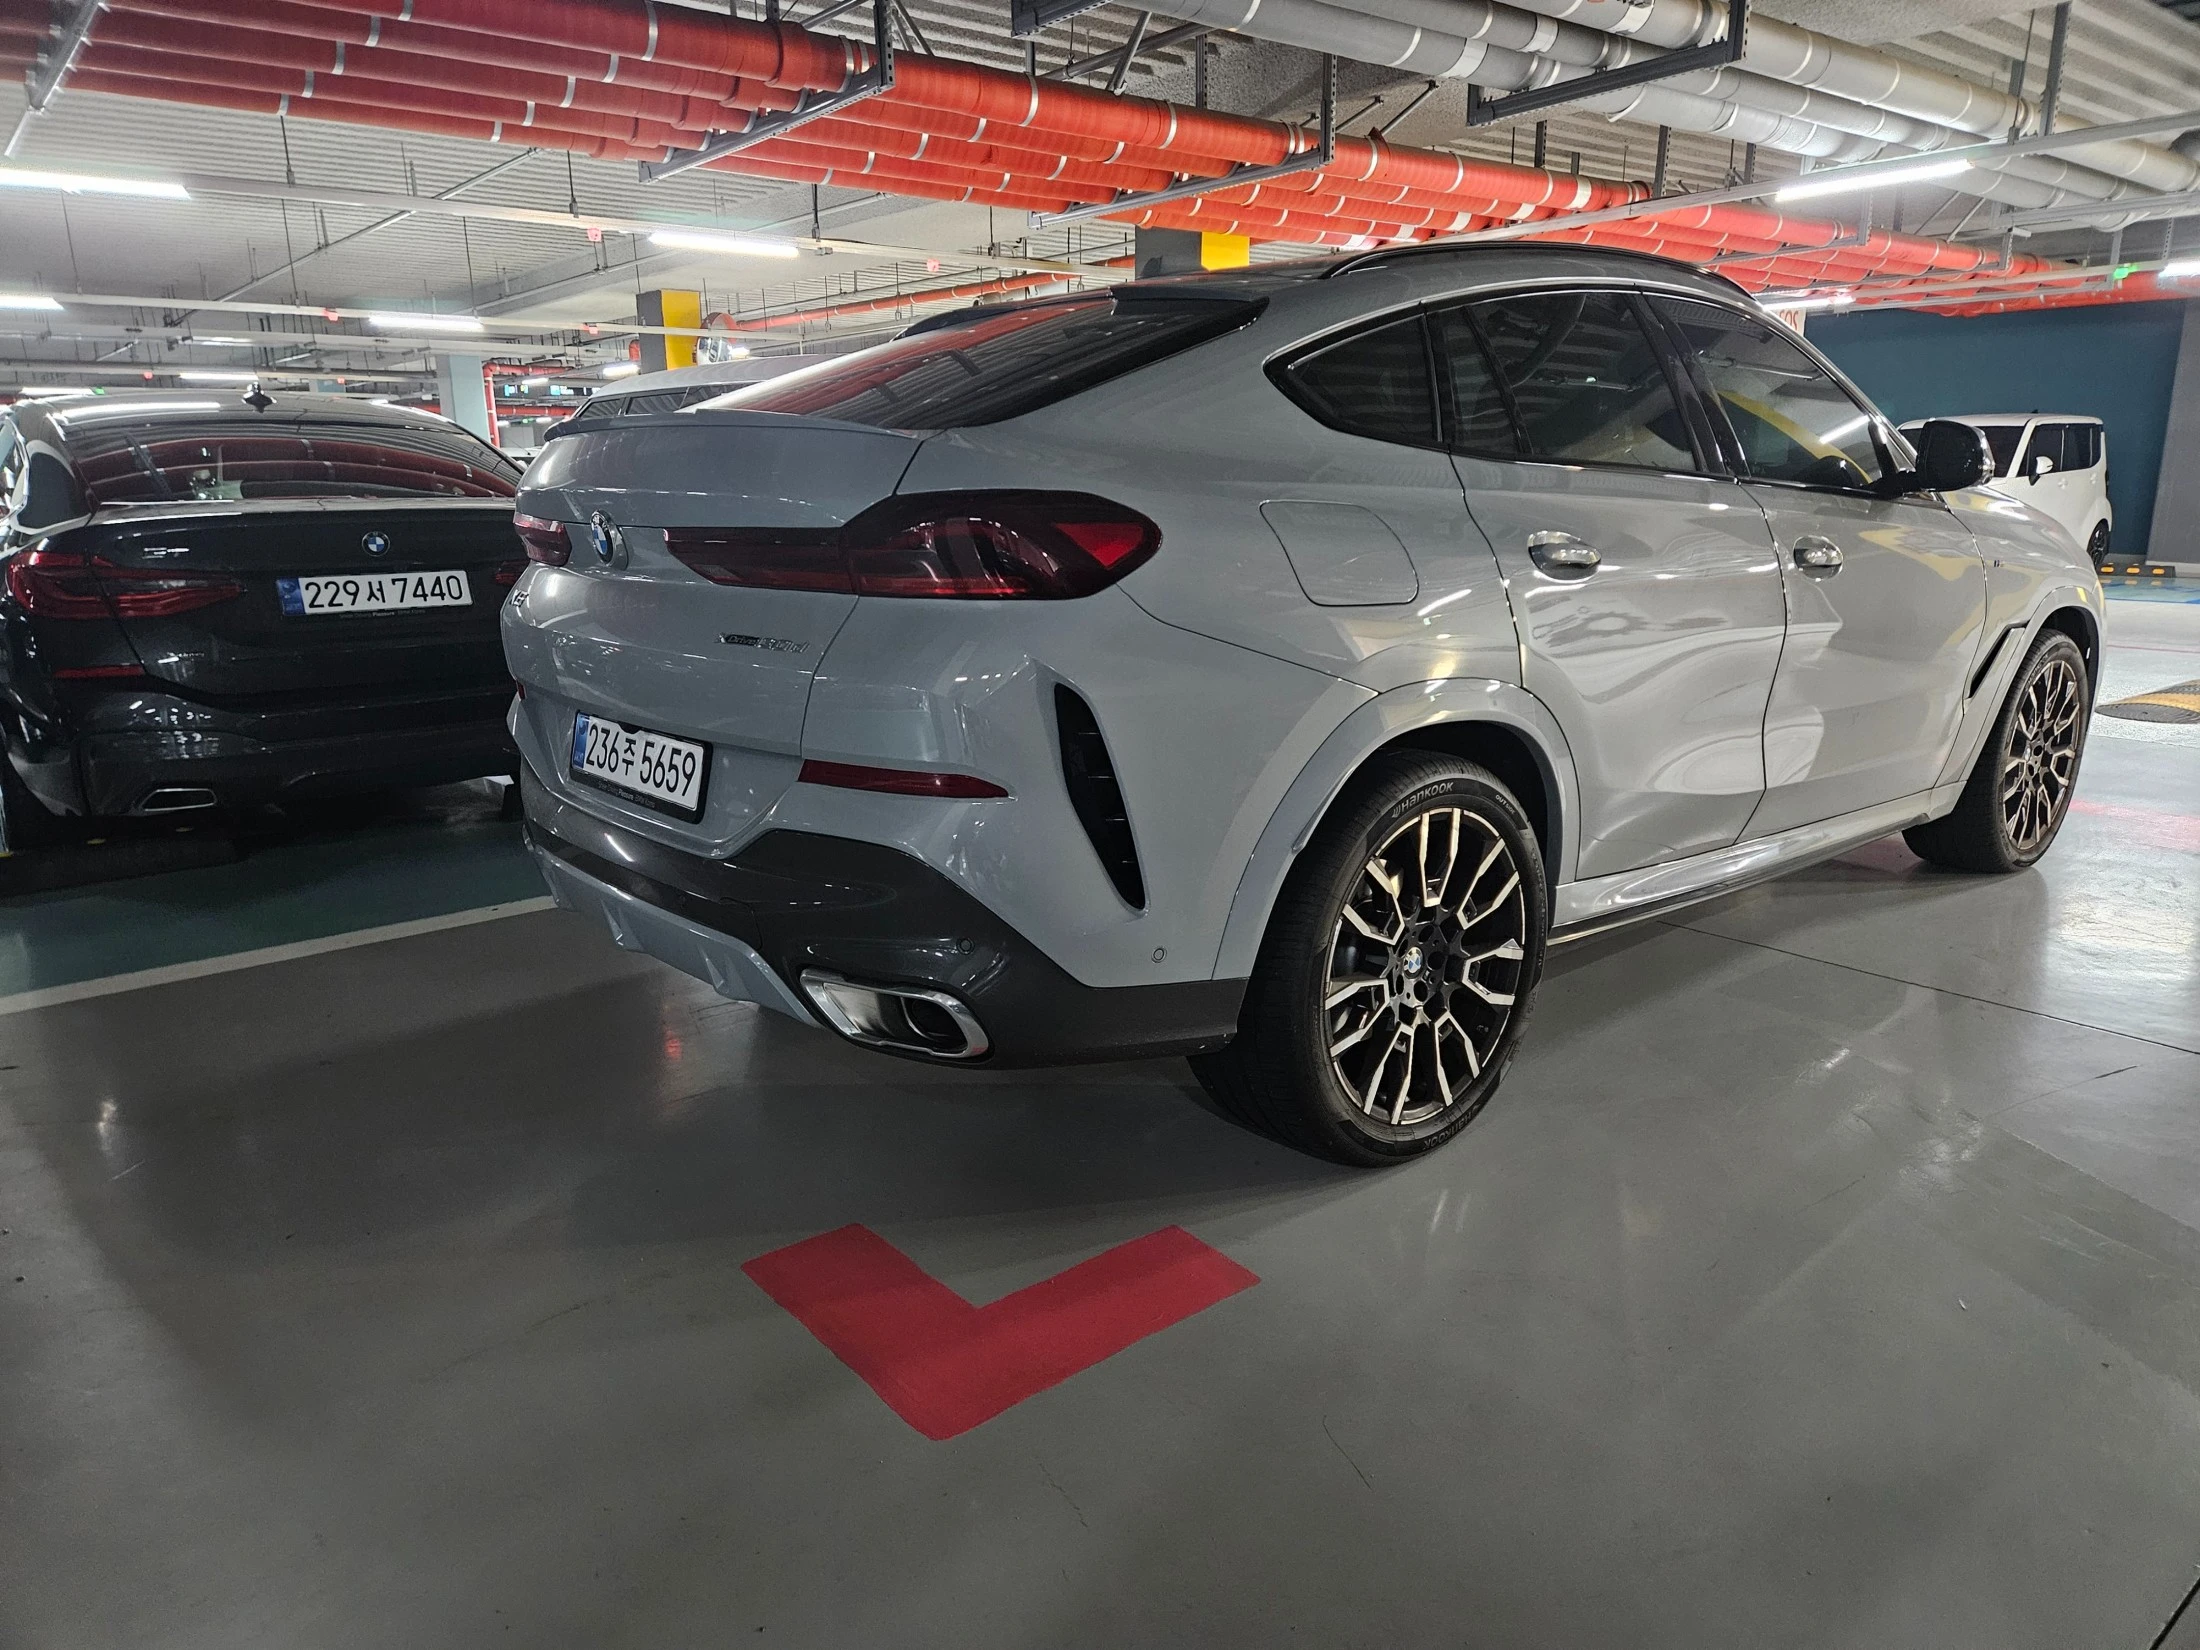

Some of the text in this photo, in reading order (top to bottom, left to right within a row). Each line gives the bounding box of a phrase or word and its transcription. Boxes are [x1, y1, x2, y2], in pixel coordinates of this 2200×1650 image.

[305, 575, 463, 609] 229서 7440
[585, 723, 696, 797] 236주 5659
